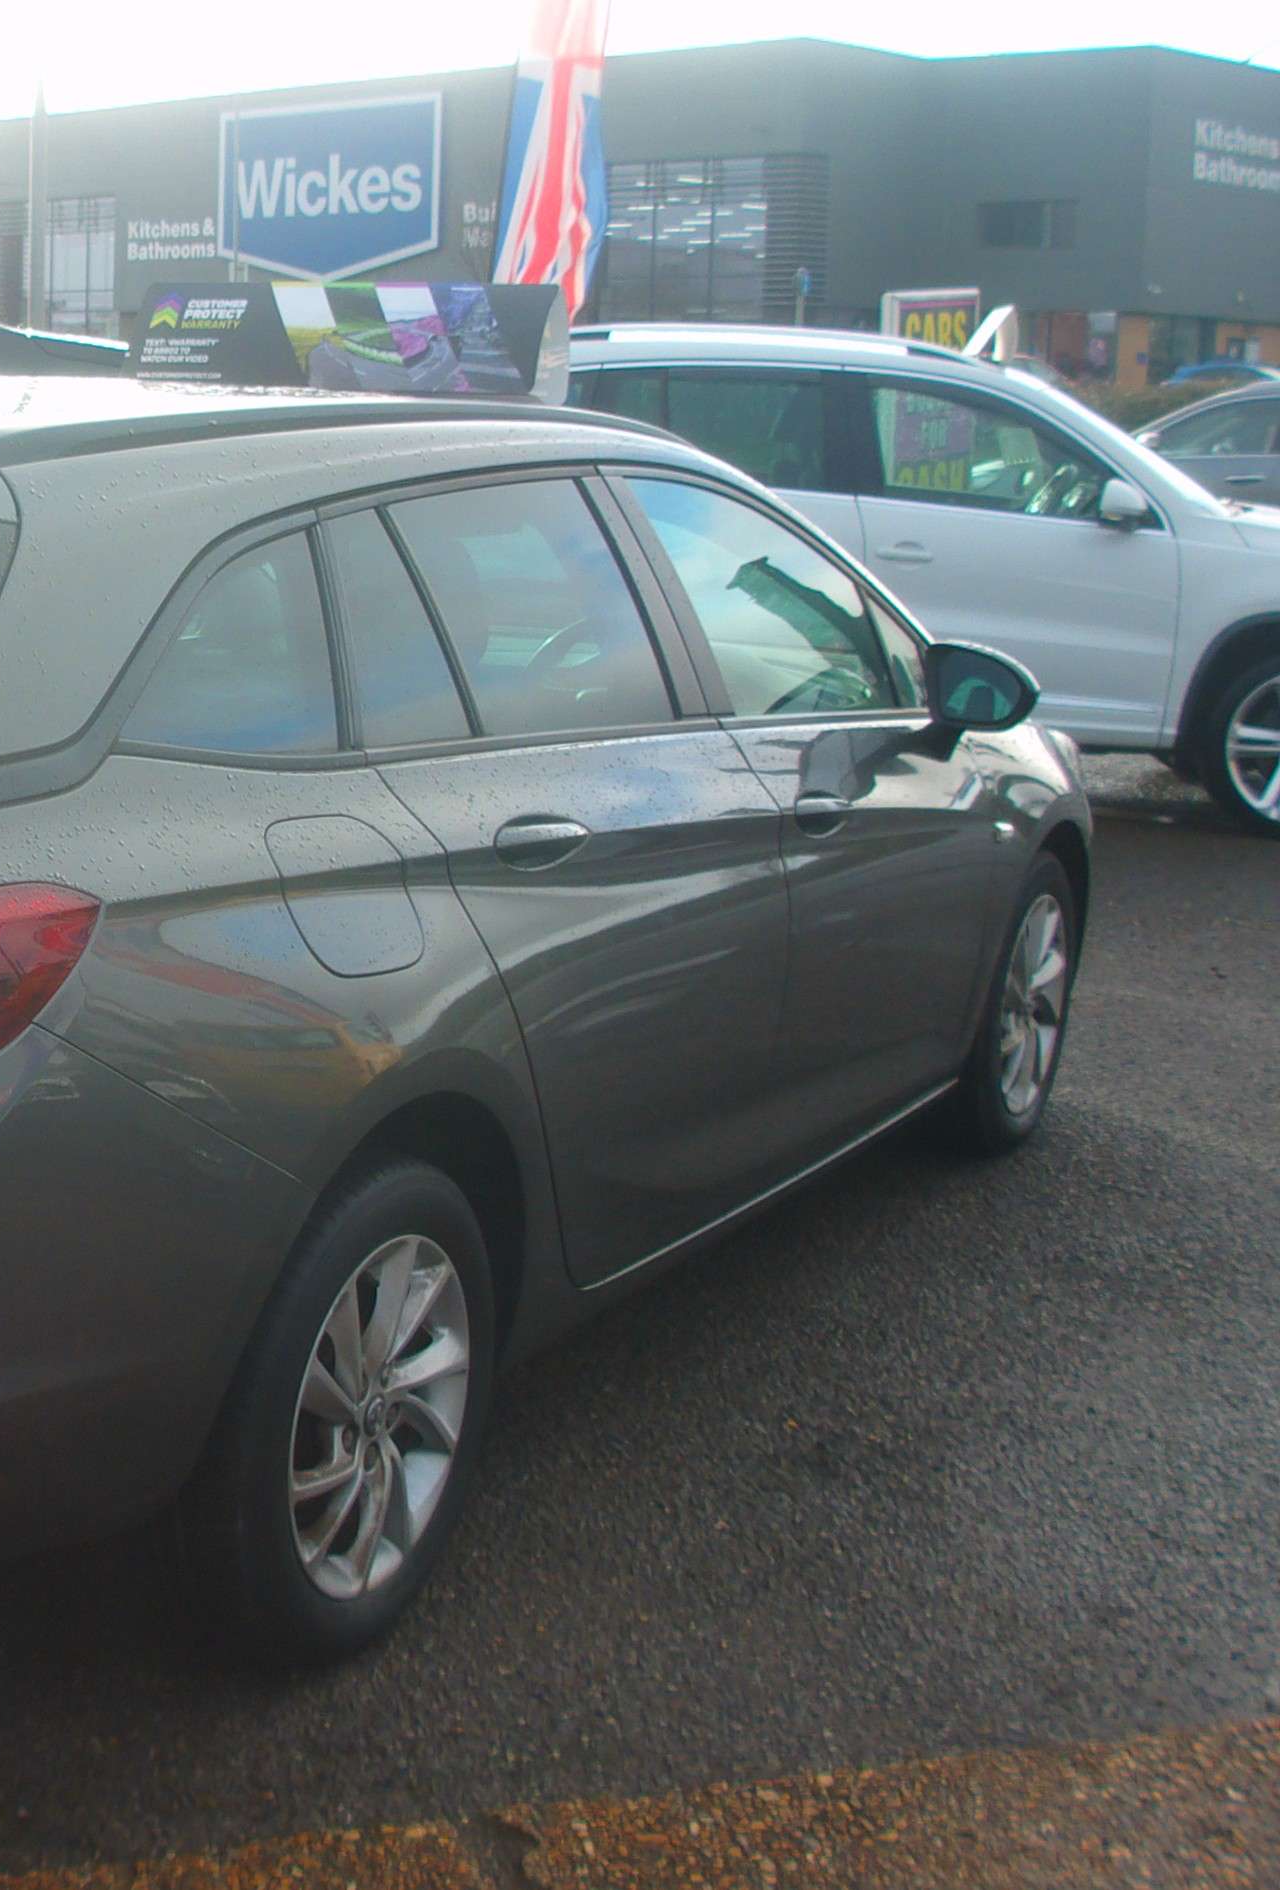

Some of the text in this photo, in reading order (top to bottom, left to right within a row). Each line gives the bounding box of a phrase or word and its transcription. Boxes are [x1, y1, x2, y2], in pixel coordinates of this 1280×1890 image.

[1195, 118, 1280, 160] Kitchens
[236, 153, 423, 220] Wickes
[128, 217, 215, 239] Kitchens &
[127, 242, 216, 260] Bathrooms
[183, 309, 245, 320] PROTECT
[187, 299, 248, 309] CUSTOMER
[905, 311, 967, 349] CARS
